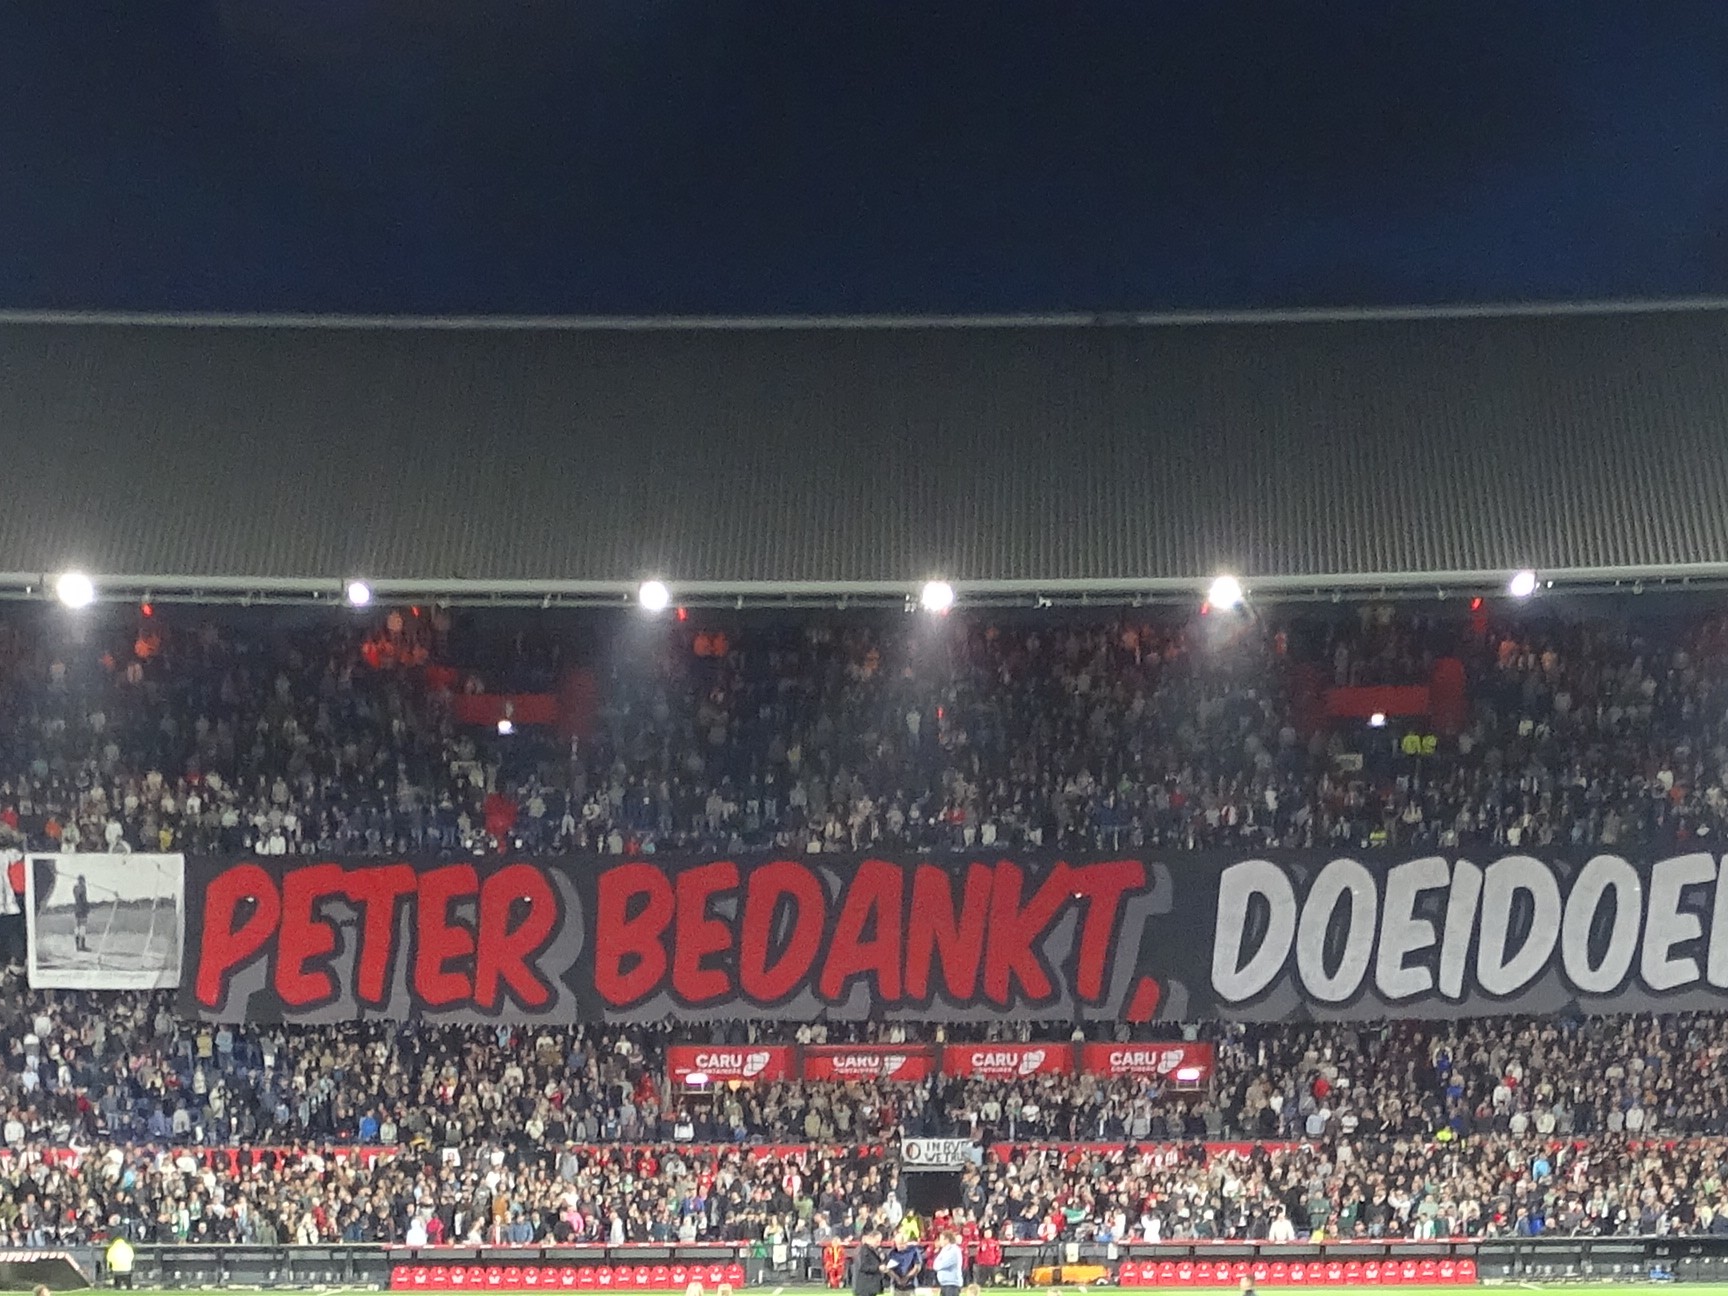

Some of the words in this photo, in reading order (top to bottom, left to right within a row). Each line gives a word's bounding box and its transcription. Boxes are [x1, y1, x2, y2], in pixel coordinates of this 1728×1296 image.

[195, 862, 559, 1009] PETER
[594, 859, 1162, 1024] BEDANKT,
[696, 1054, 742, 1068] CARU
[972, 1052, 1018, 1067] CARU
[1109, 1051, 1156, 1066] CARU
